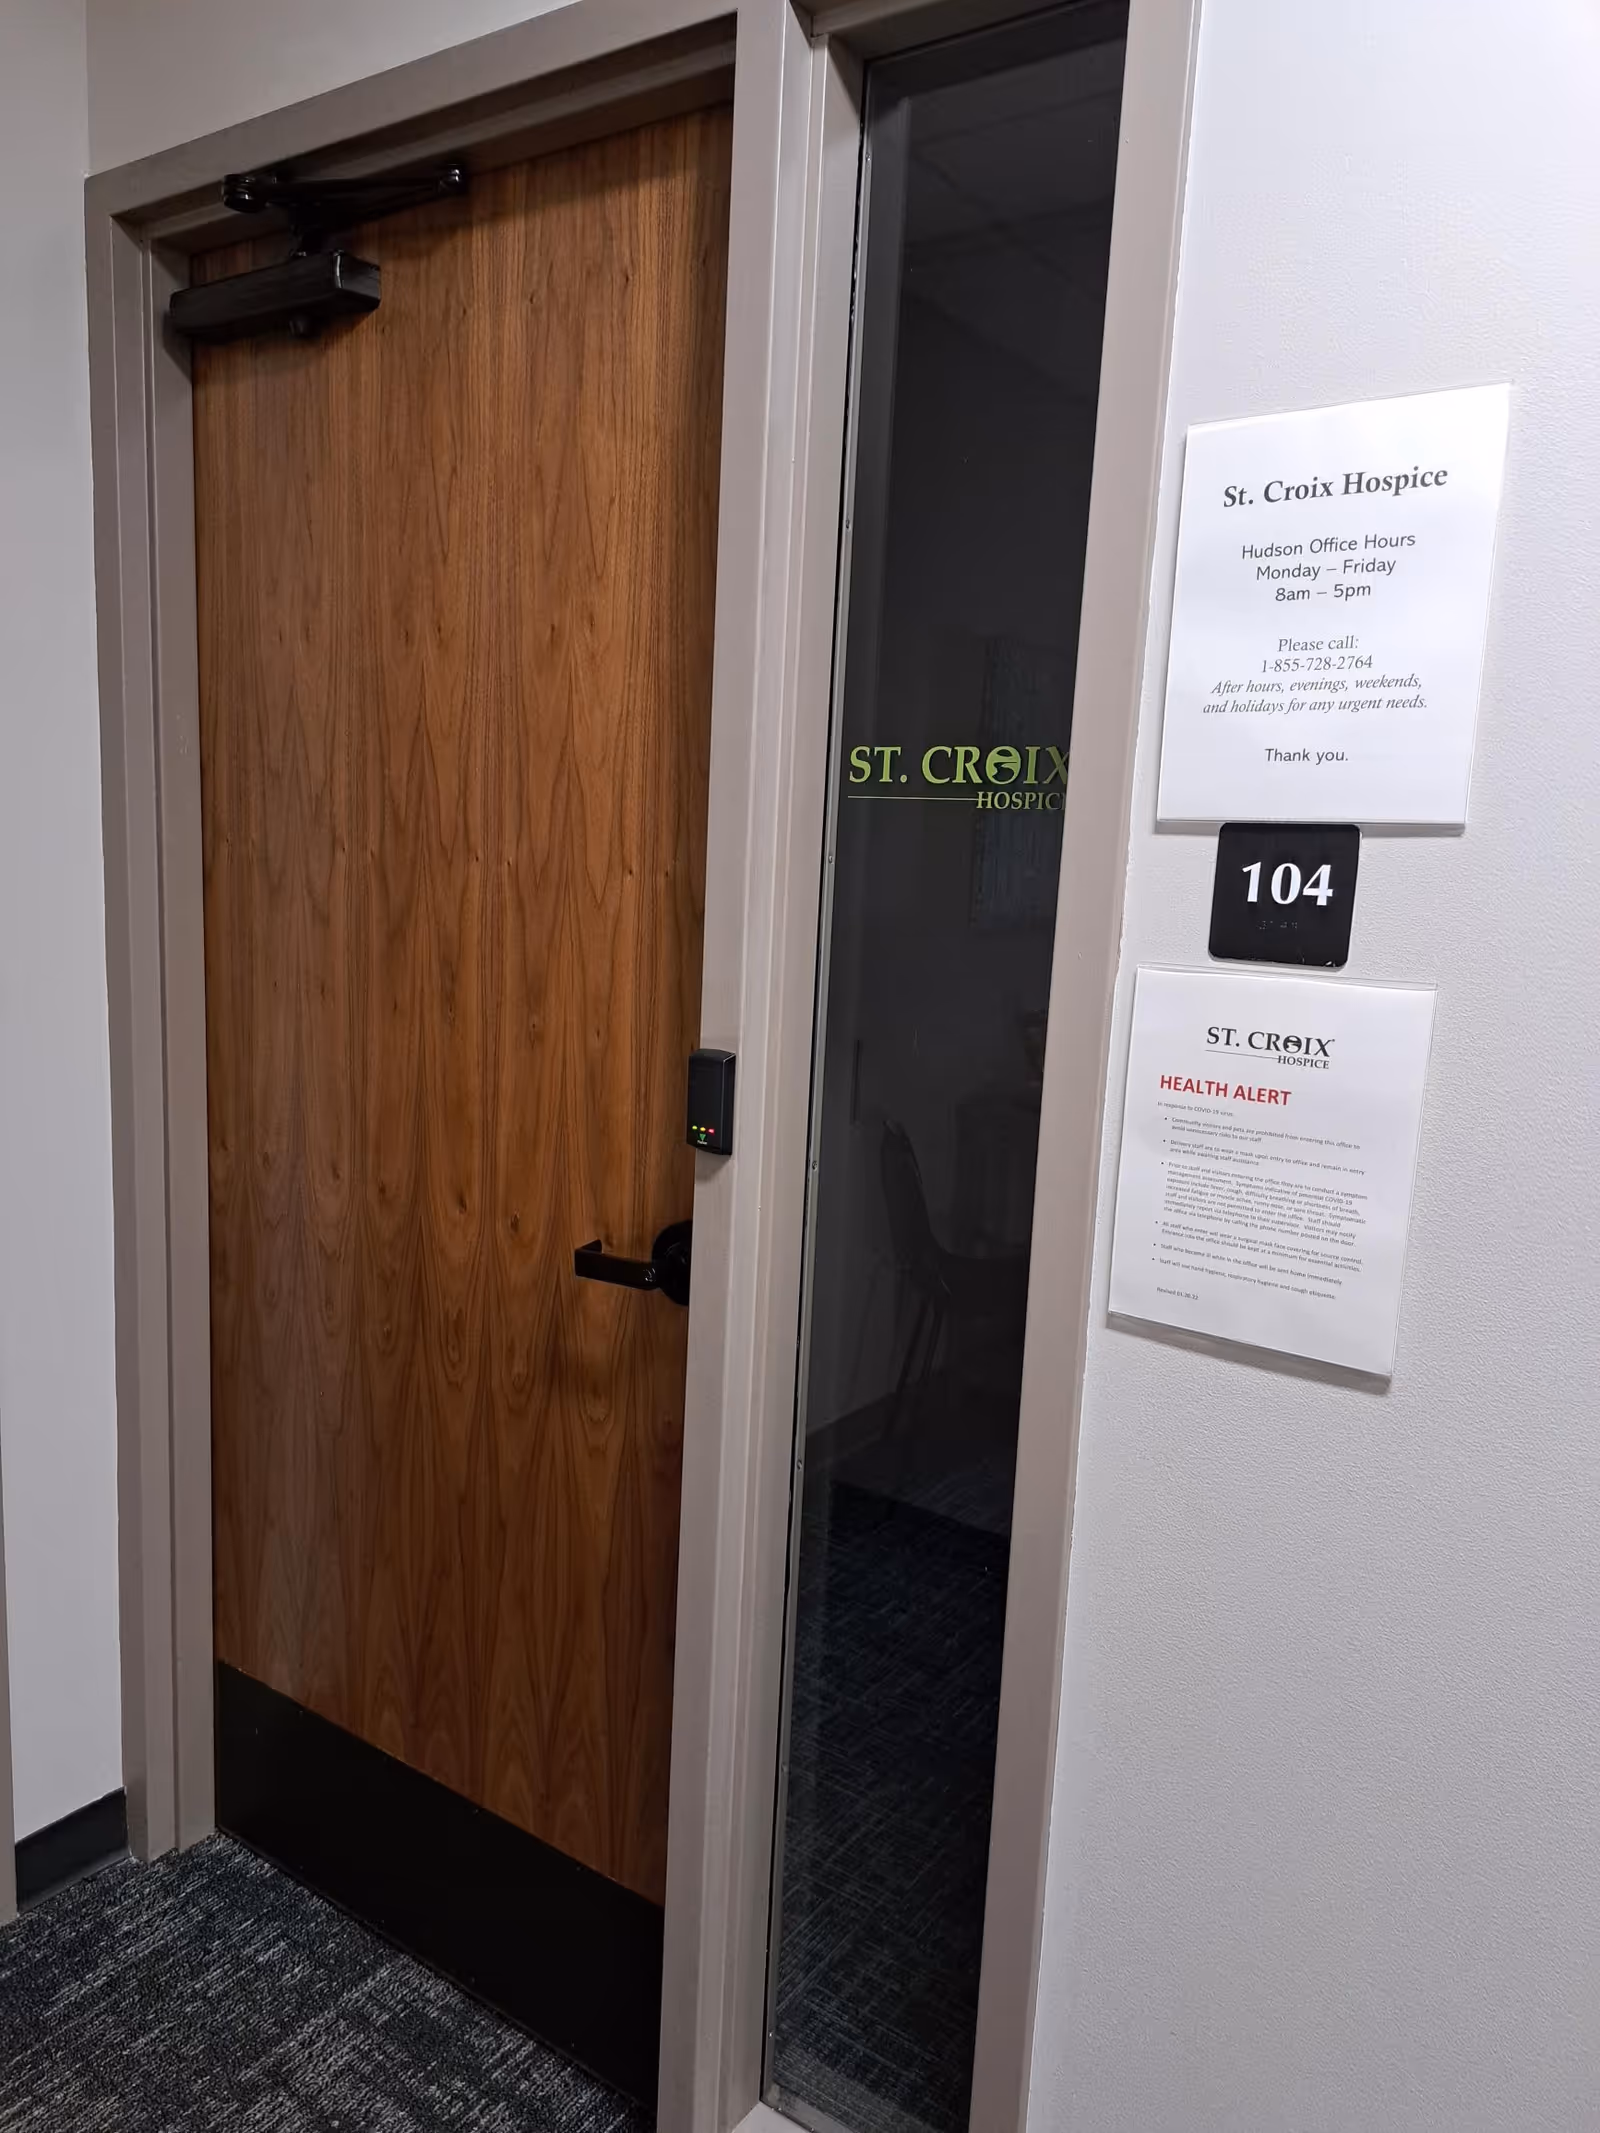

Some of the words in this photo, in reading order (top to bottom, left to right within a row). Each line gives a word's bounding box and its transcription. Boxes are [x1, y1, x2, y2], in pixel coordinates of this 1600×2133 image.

[1223, 485, 1254, 508] St.
[1263, 477, 1334, 504] Croix
[1341, 465, 1449, 497] Hospice
[1241, 543, 1303, 560] Hudson
[1309, 537, 1358, 554] Office
[1364, 533, 1416, 550] Hours
[1256, 563, 1322, 582] Monday
[1342, 557, 1397, 577] Friday
[1275, 587, 1311, 602] 8am
[1333, 584, 1371, 602] 5pm
[1278, 638, 1324, 653] Please
[1327, 635, 1360, 650] call:
[1261, 655, 1373, 673] 1-855-728-2764
[1211, 679, 1243, 696] After
[1246, 680, 1285, 694] hours,
[1290, 678, 1348, 694] evenings,
[1355, 673, 1422, 690] weekends,
[1203, 700, 1228, 714] and
[1230, 699, 1285, 715] holidays
[1284, 698, 1308, 715] for
[1309, 701, 1335, 714] any
[1338, 699, 1384, 713] urgent
[1386, 695, 1428, 709] needs.
[849, 745, 908, 783] ST.
[921, 745, 1069, 785] CROIX
[1265, 747, 1311, 762] Thank
[1316, 751, 1349, 766] you.
[976, 791, 1066, 810] HOSPIC
[1242, 861, 1334, 906] 104
[1206, 1026, 1241, 1048] ST.
[1247, 1031, 1331, 1058] CROIX
[1277, 1054, 1330, 1070] HOSPICE
[1160, 1076, 1229, 1098] HEALTH
[1232, 1085, 1292, 1106] ALERT
